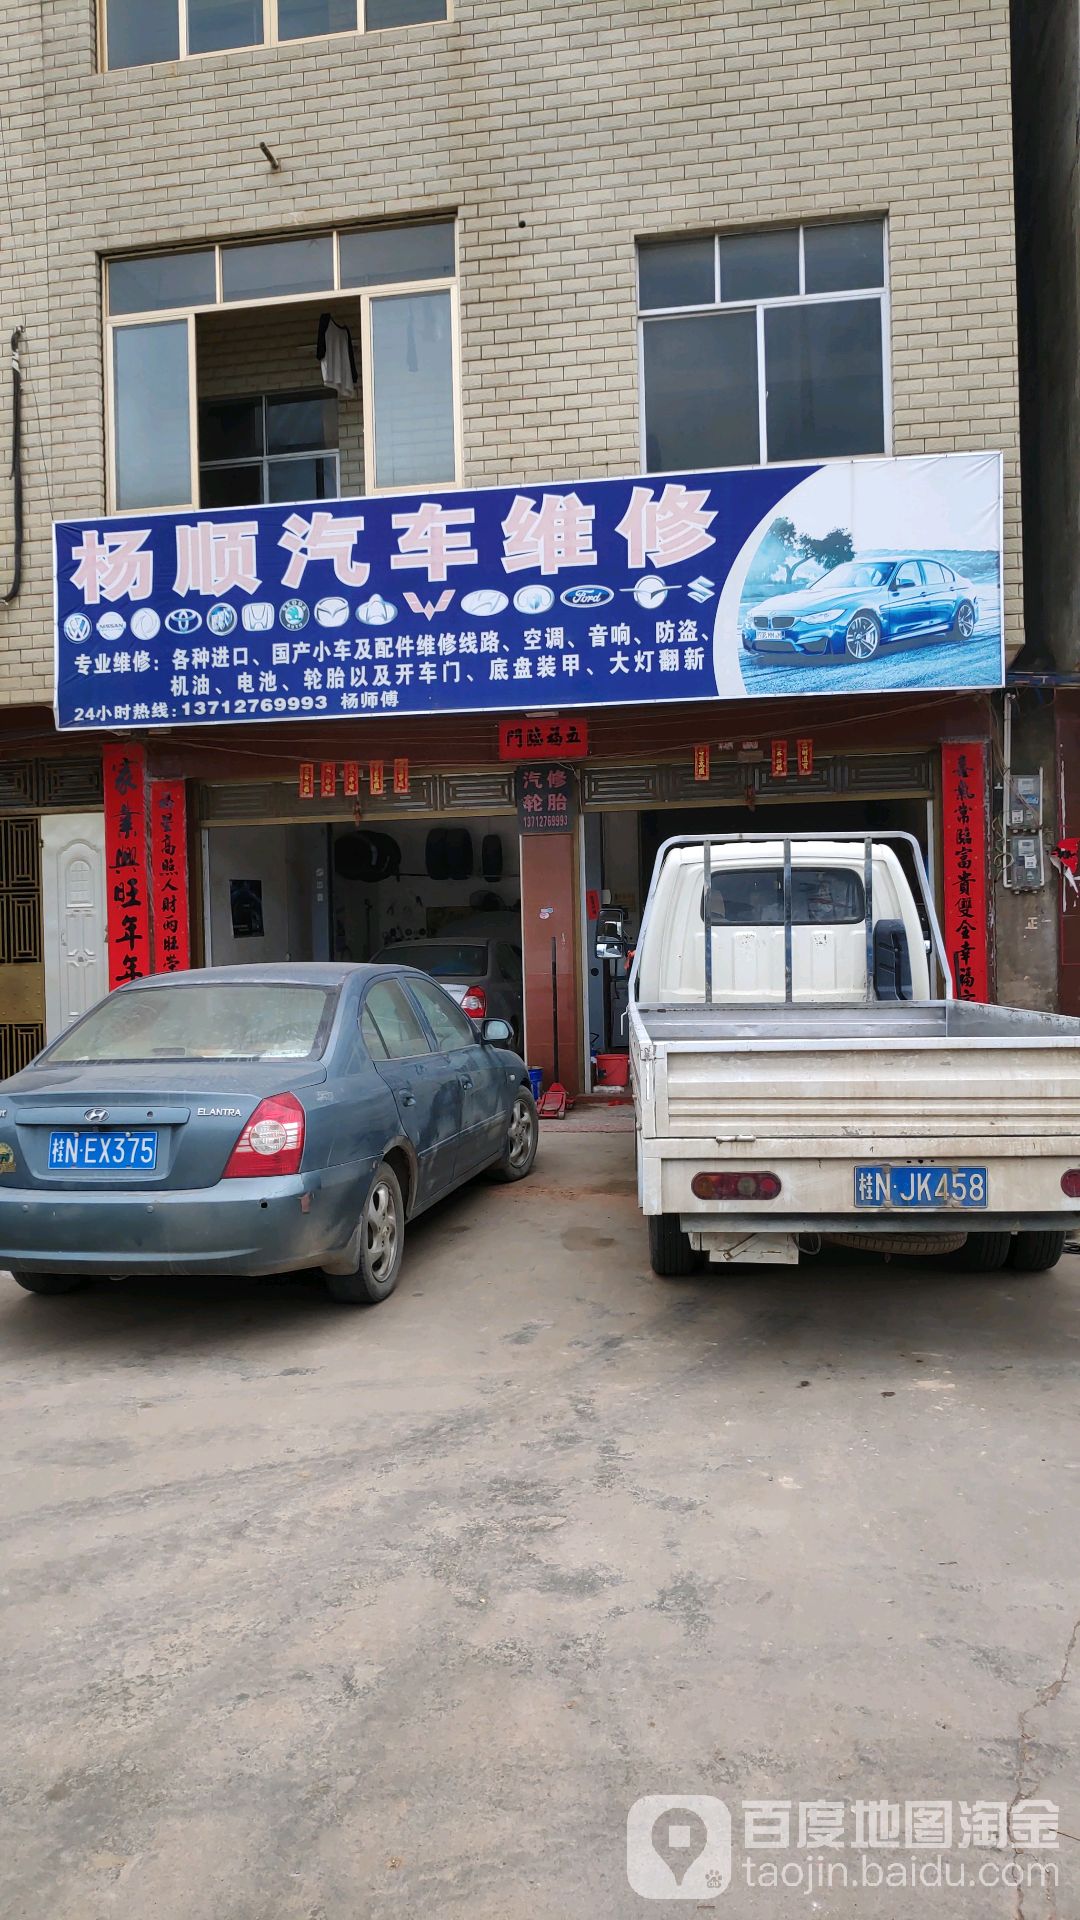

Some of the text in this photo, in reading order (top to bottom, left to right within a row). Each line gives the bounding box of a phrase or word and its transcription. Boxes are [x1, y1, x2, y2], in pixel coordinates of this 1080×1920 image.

[70, 483, 719, 605] 杨顺汽车维修
[572, 589, 602, 604] Ford
[340, 690, 399, 709] 杨师傅
[523, 770, 567, 789] 汽修
[523, 793, 567, 813] 轮胎
[523, 815, 568, 828] 13712769993
[197, 1107, 242, 1117] ELANTRA
